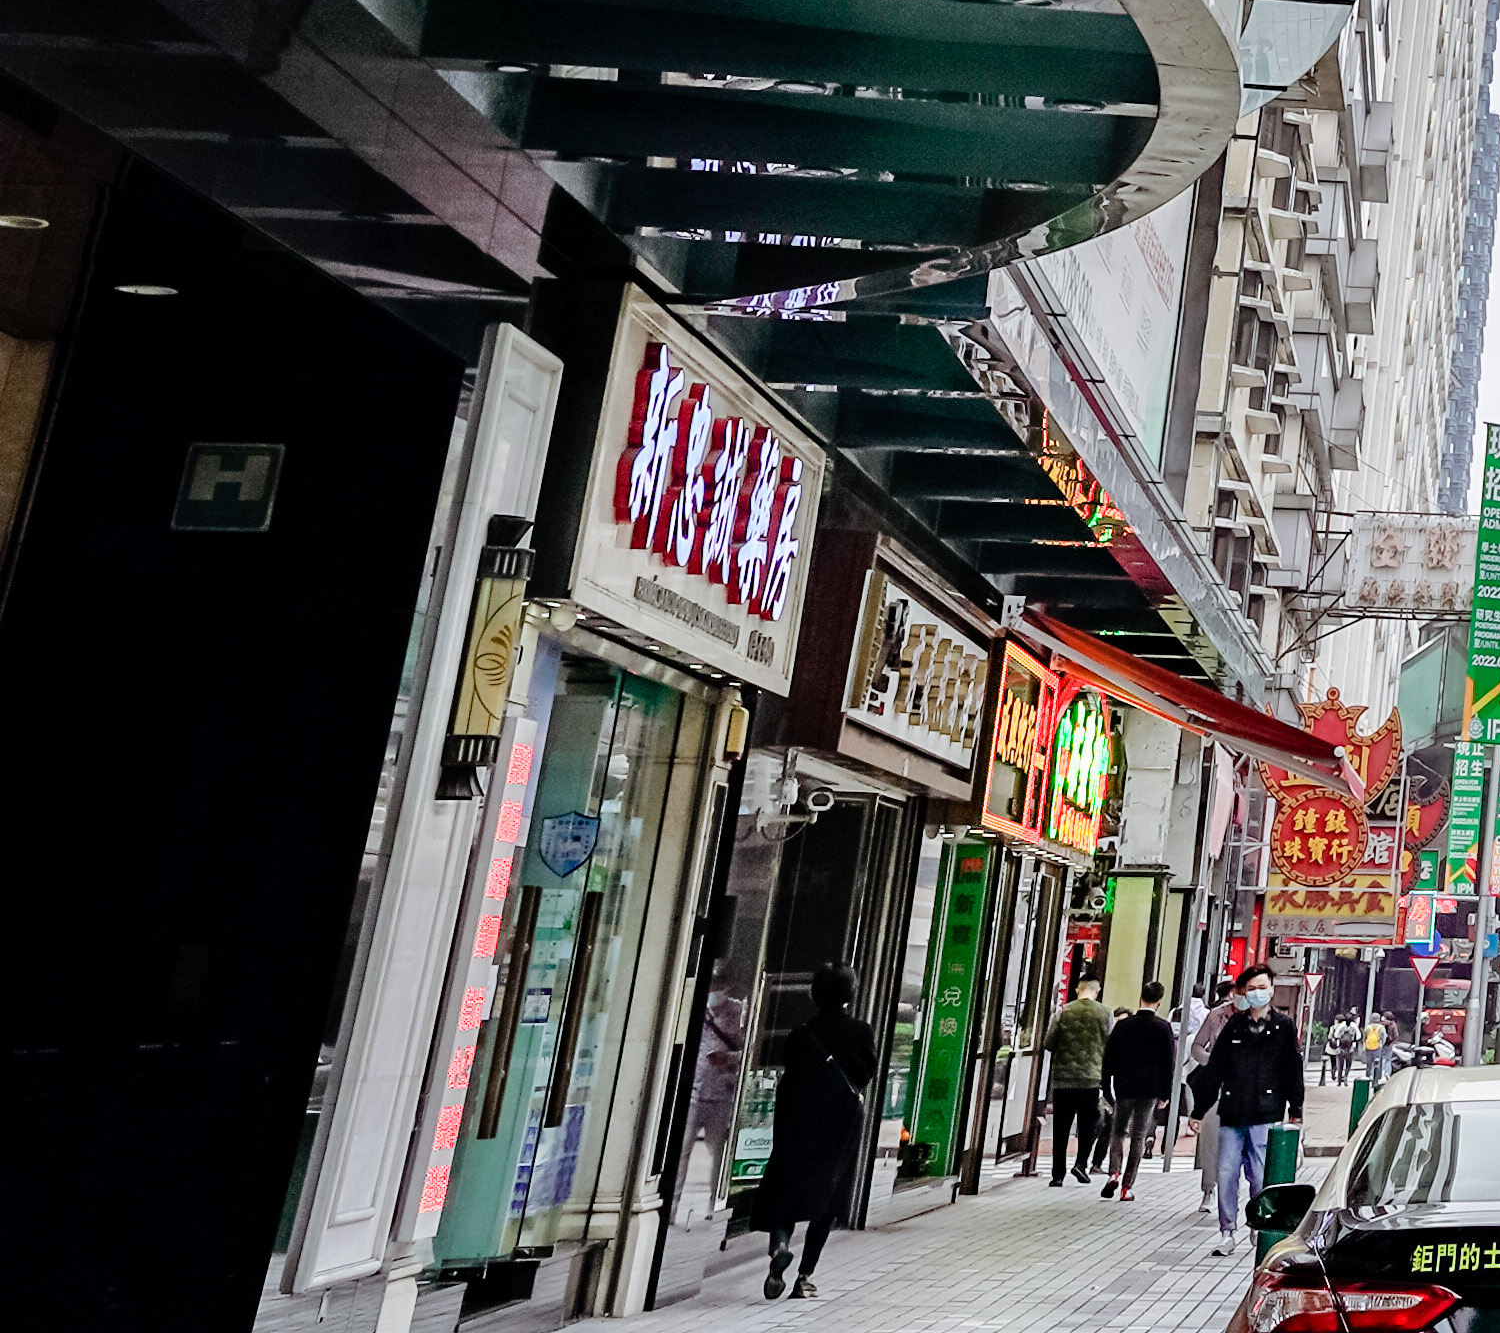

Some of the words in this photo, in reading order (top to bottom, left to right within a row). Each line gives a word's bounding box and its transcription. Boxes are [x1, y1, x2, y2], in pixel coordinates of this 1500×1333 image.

[1293, 808, 1350, 834] 鐘錶
[1283, 836, 1354, 865] 珠寶行
[1456, 882, 1475, 895] IPM
